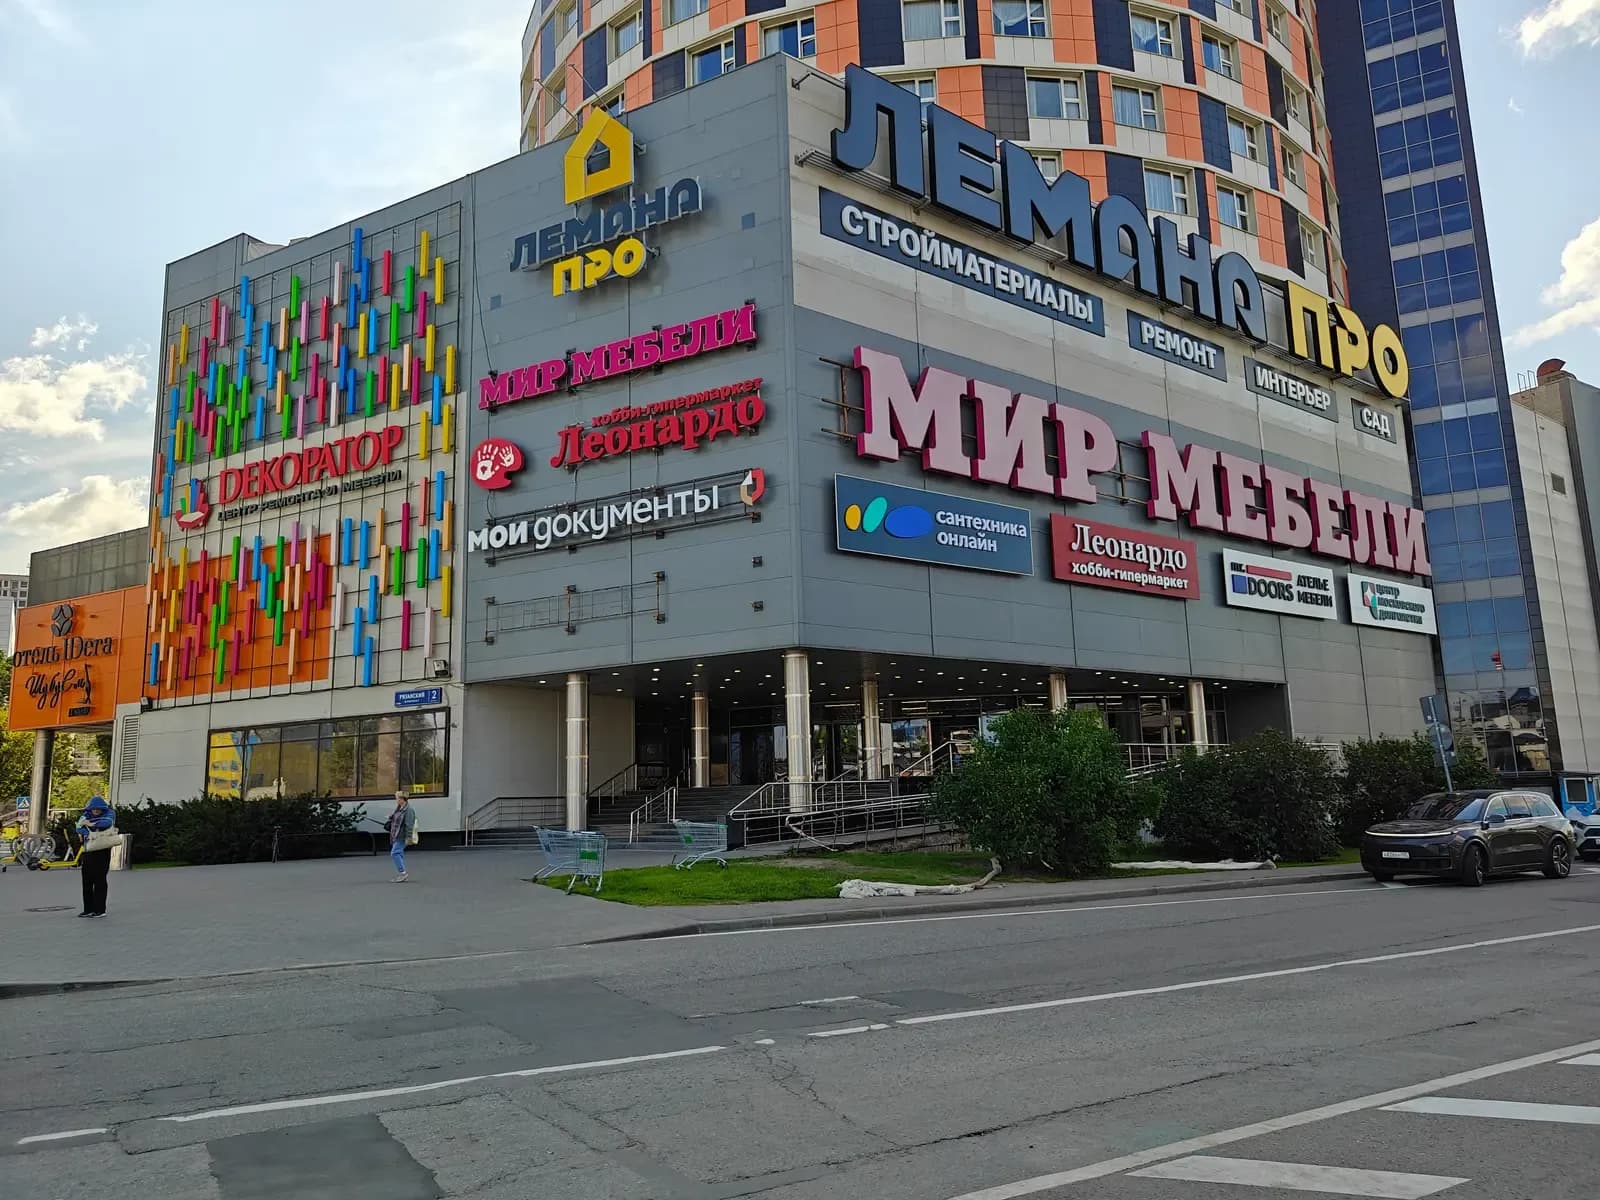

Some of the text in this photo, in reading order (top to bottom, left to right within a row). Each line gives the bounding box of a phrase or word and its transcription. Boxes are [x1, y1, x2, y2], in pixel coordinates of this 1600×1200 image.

[510, 175, 703, 272] ЛЕМАНА
[831, 62, 1409, 399] ЛЕМАНА ПРО
[553, 237, 648, 296] ПРО
[841, 204, 1094, 324] СТРОЙМАТЕРИАЛЫ
[478, 302, 758, 410] МИР МЕБЕЛИ
[1140, 320, 1217, 371] РЕМОНТ
[591, 377, 764, 428] хобби-гипермаркет
[1254, 366, 1332, 412] ИНТЕРЬЕР
[550, 395, 766, 468] Леонардо
[1360, 405, 1391, 438] САД
[853, 345, 1432, 576] МИР МЕБЕЛИ
[218, 503, 259, 521] ЦЕНТР
[260, 489, 323, 512] РЕМОНТА
[342, 470, 402, 493] МЕБЕЛИ
[468, 485, 720, 552] мои документы
[935, 508, 1028, 539] сантехника
[936, 529, 998, 553] онлайн
[1071, 523, 1188, 572] Леонардо
[1071, 561, 1189, 592] хобби-гипермаркет
[1247, 576, 1294, 602] DOORS
[1296, 574, 1330, 592] АТЕЛЬЕ
[1297, 589, 1333, 608] МЕБЕЛИ
[13, 645, 60, 668] отель
[431, 689, 437, 699] 2
